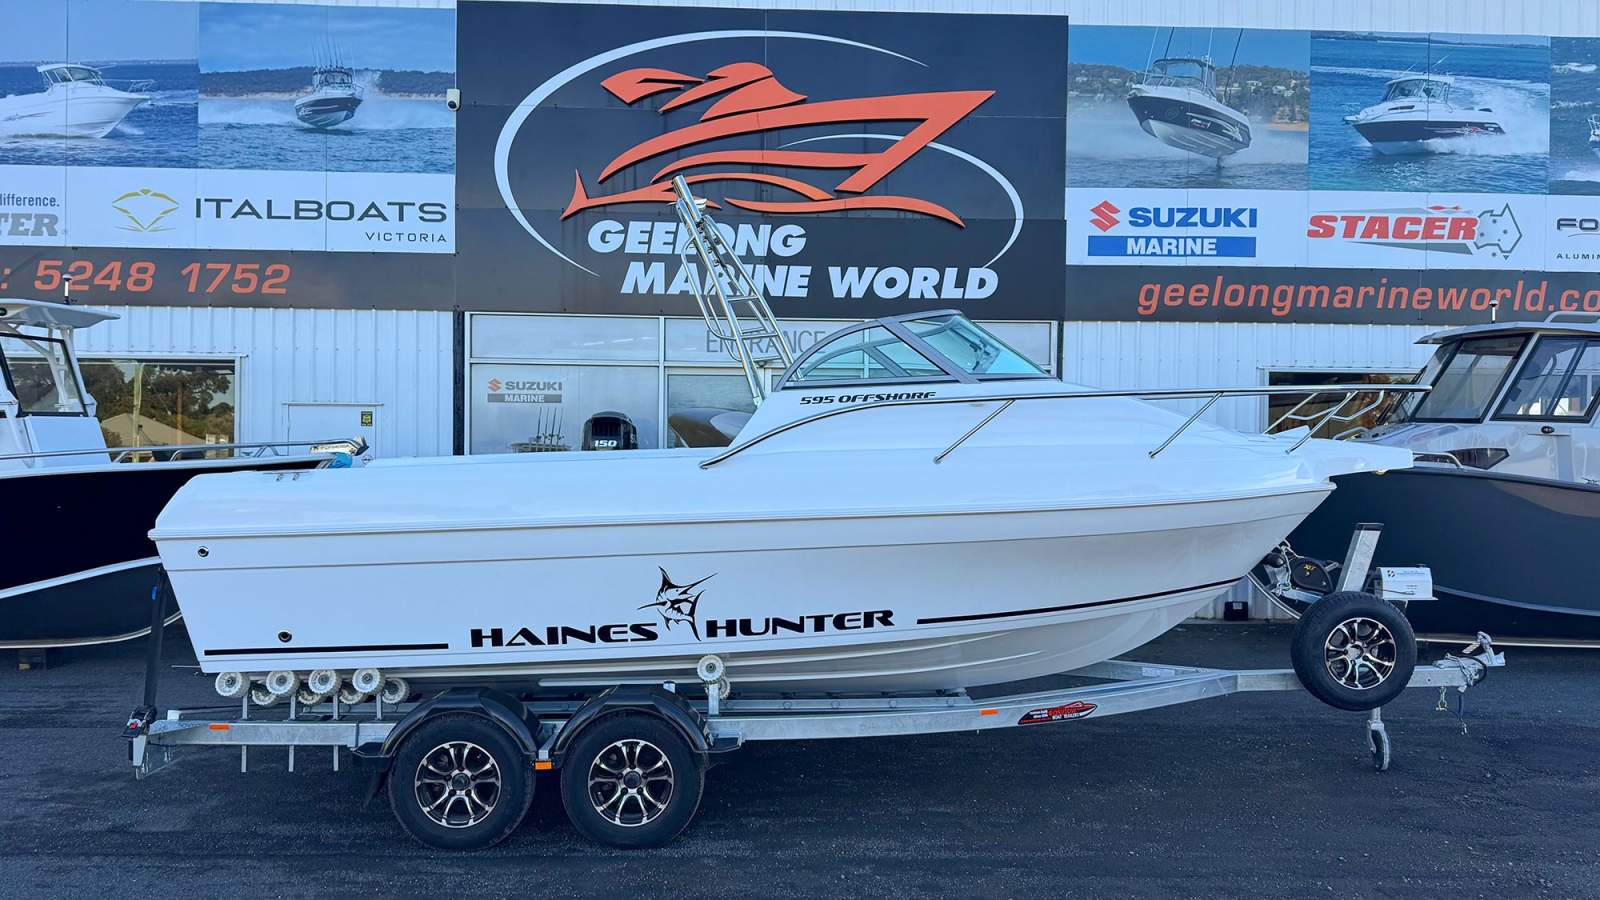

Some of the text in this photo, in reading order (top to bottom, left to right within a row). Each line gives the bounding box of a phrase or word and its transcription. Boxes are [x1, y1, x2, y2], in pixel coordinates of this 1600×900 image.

[195, 197, 448, 222] ITALBOATS
[1127, 206, 1258, 229] SUZUKI
[365, 231, 448, 243] VICTORIA
[1306, 214, 1479, 241] STACER
[1126, 236, 1218, 256] MARINE
[34, 259, 156, 292] 5248
[180, 263, 291, 295] 1752
[828, 265, 999, 300] WORLD
[706, 329, 826, 354] ENRANCE
[504, 381, 562, 391] SUZUKI
[504, 394, 545, 403] MARINE
[800, 391, 937, 405] 595 OFFSHORE
[594, 439, 618, 448] 150
[470, 609, 895, 648] HAINES HUNTER
